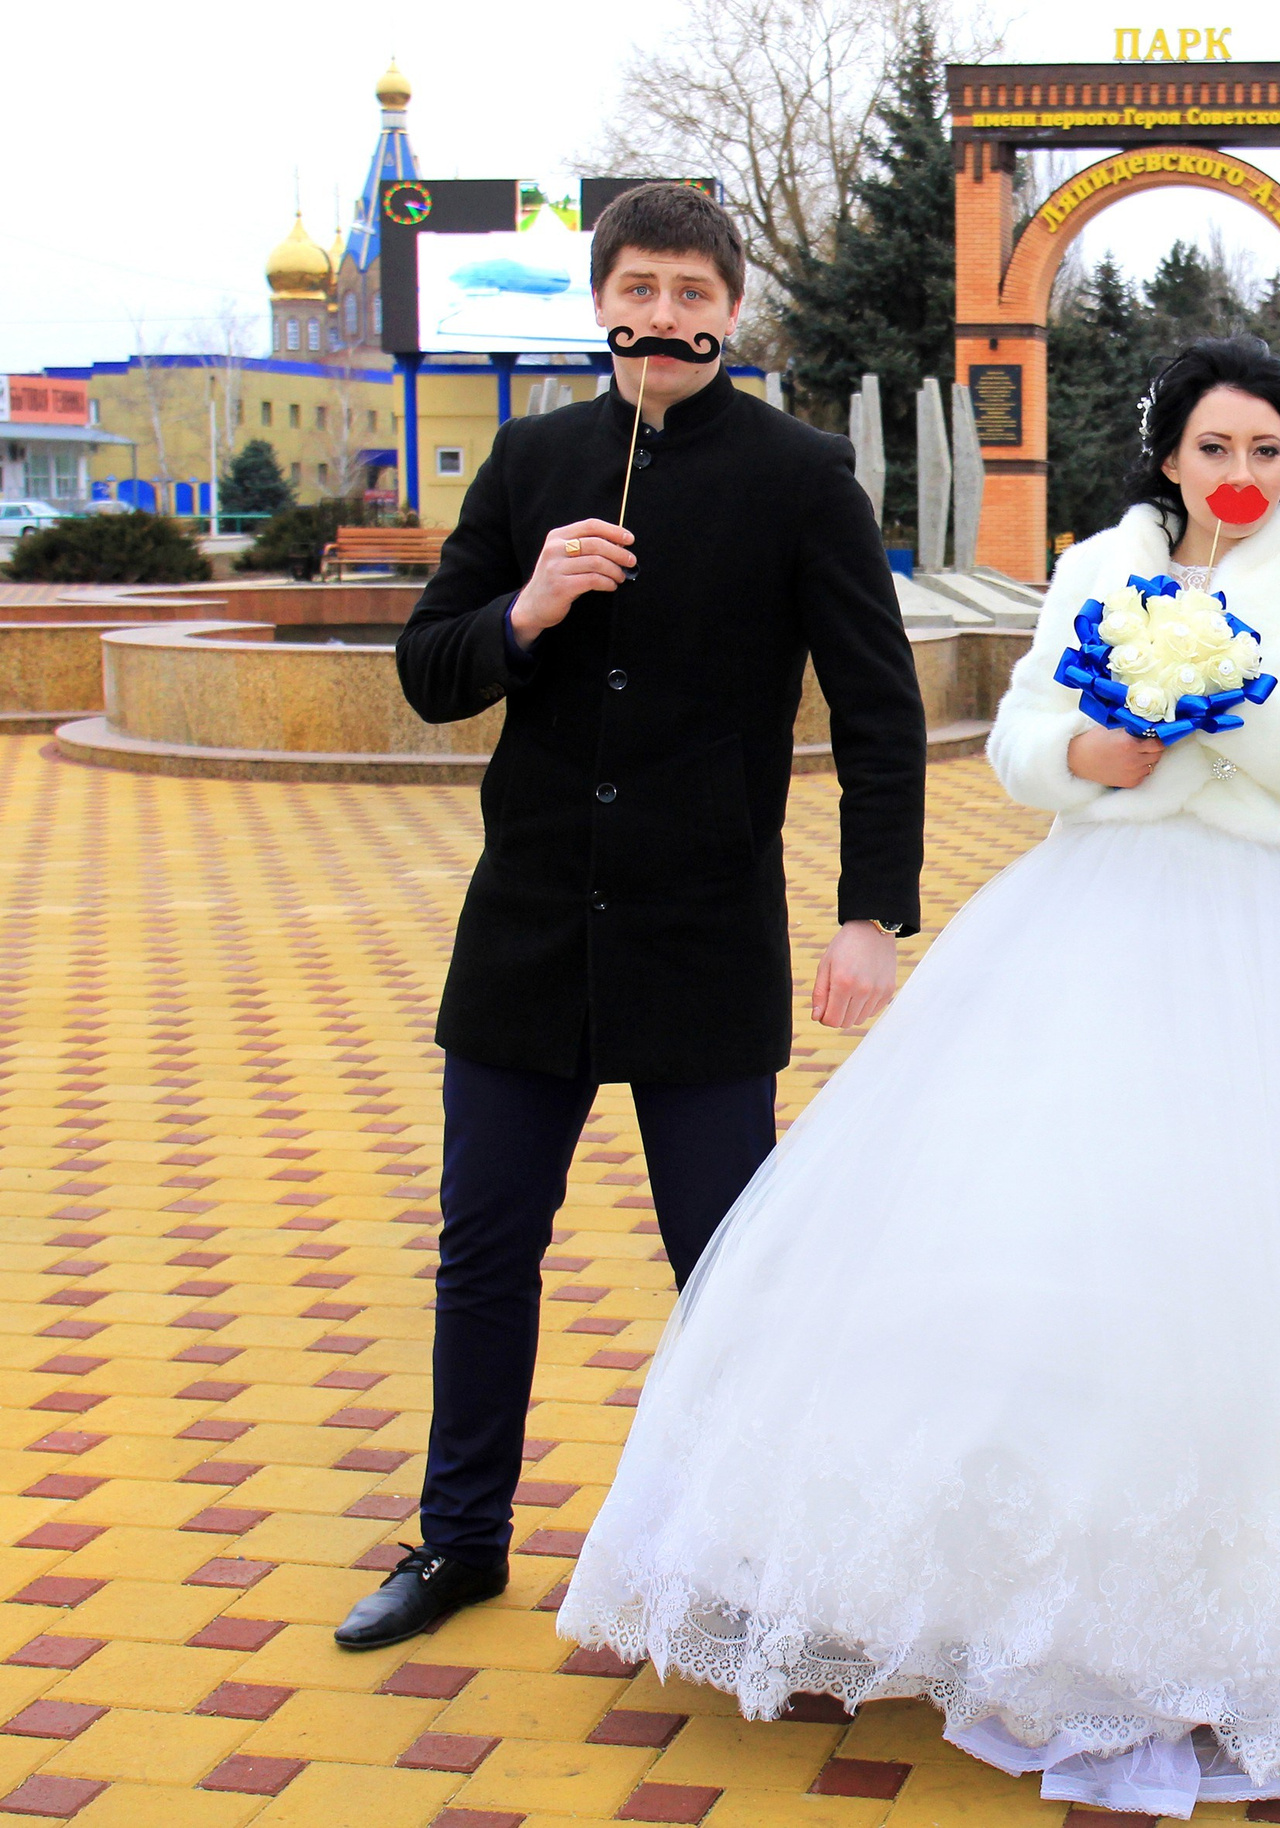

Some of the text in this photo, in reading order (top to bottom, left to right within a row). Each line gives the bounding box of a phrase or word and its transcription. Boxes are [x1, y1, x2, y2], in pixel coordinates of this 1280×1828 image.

[1114, 27, 1233, 61] ПАРК
[972, 112, 1037, 127] имени
[1041, 111, 1119, 130] первого
[1123, 107, 1181, 130] Героя
[1040, 151, 1246, 234] Ляпидевского
